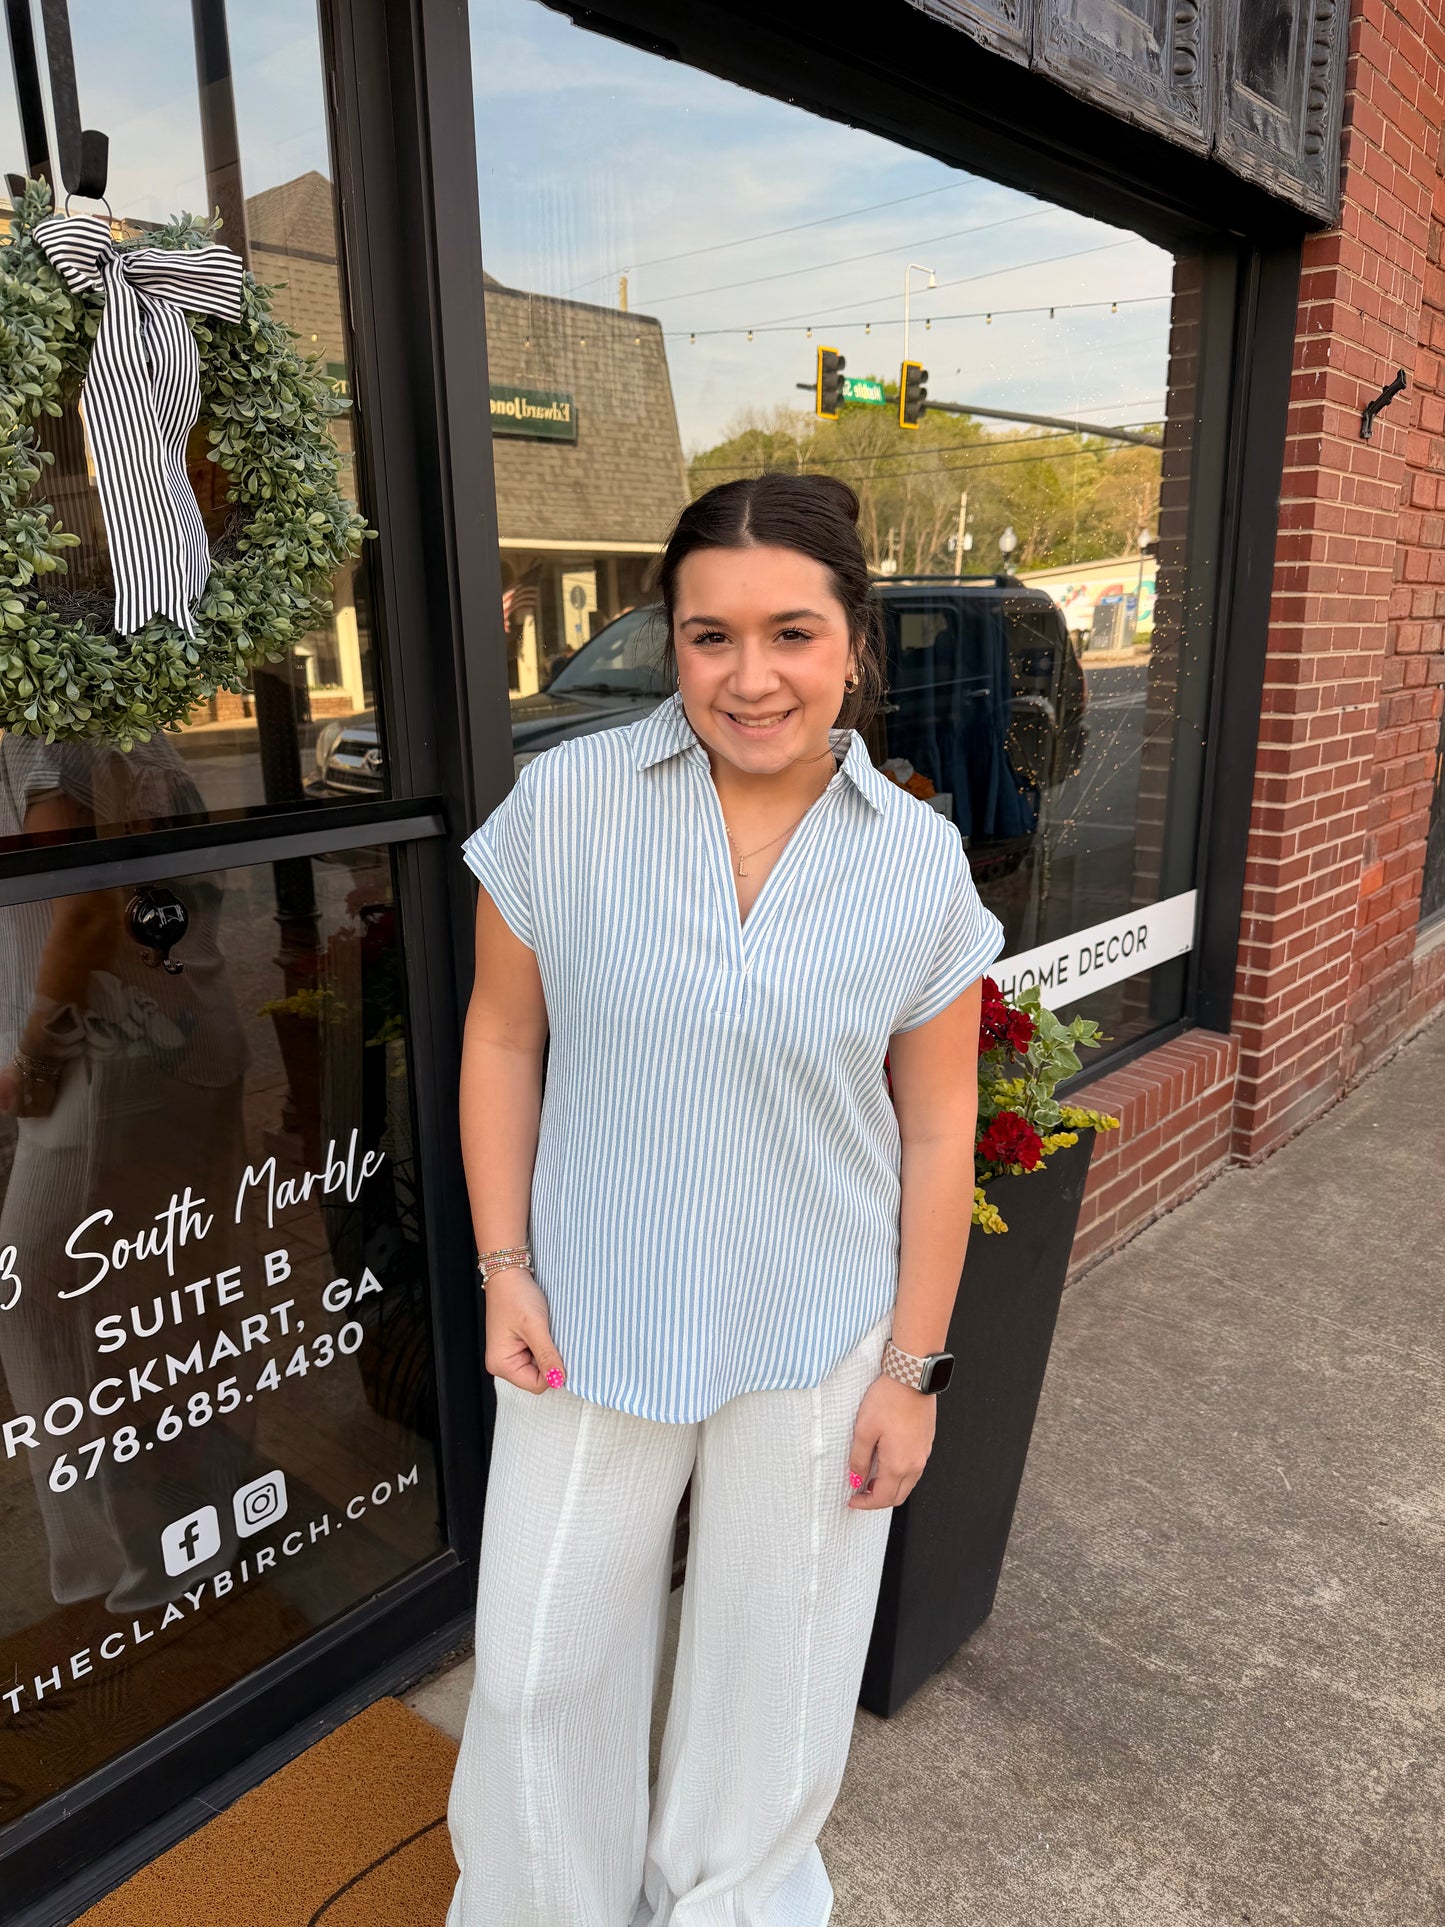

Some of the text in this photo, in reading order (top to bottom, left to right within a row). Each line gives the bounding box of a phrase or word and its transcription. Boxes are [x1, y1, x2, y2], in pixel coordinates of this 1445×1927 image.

[1001, 924, 1148, 1002] HOME DECOR
[57, 1186, 214, 1299] South
[235, 1127, 386, 1229] Marble
[1, 1266, 384, 1459] ROCKMART, GA
[94, 1249, 292, 1353] SUITE B
[48, 1321, 365, 1493] 678.685.4430
[2, 1464, 419, 1714] THECLAYBIRCH.COM
